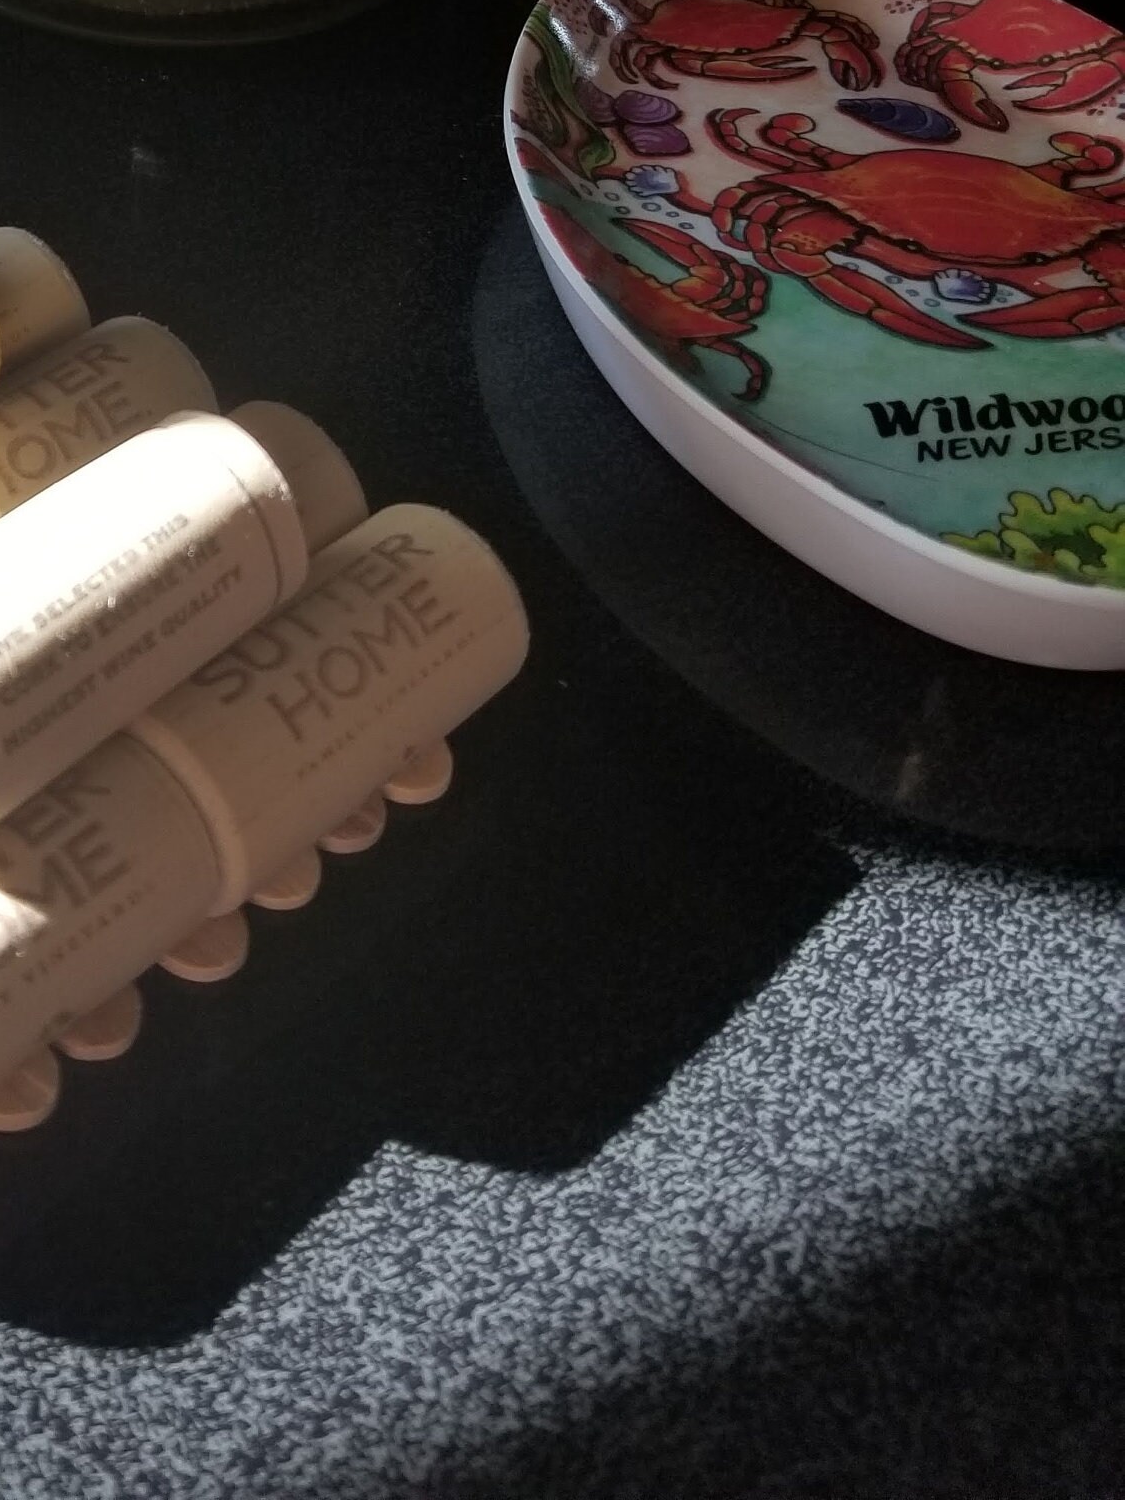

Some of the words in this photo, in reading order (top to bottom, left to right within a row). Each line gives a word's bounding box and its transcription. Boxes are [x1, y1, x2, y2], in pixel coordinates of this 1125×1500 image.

[916, 434, 1011, 463] NEW
[140, 514, 188, 552] THIS
[191, 531, 433, 707] SUTTER
[268, 578, 462, 742] HOME
